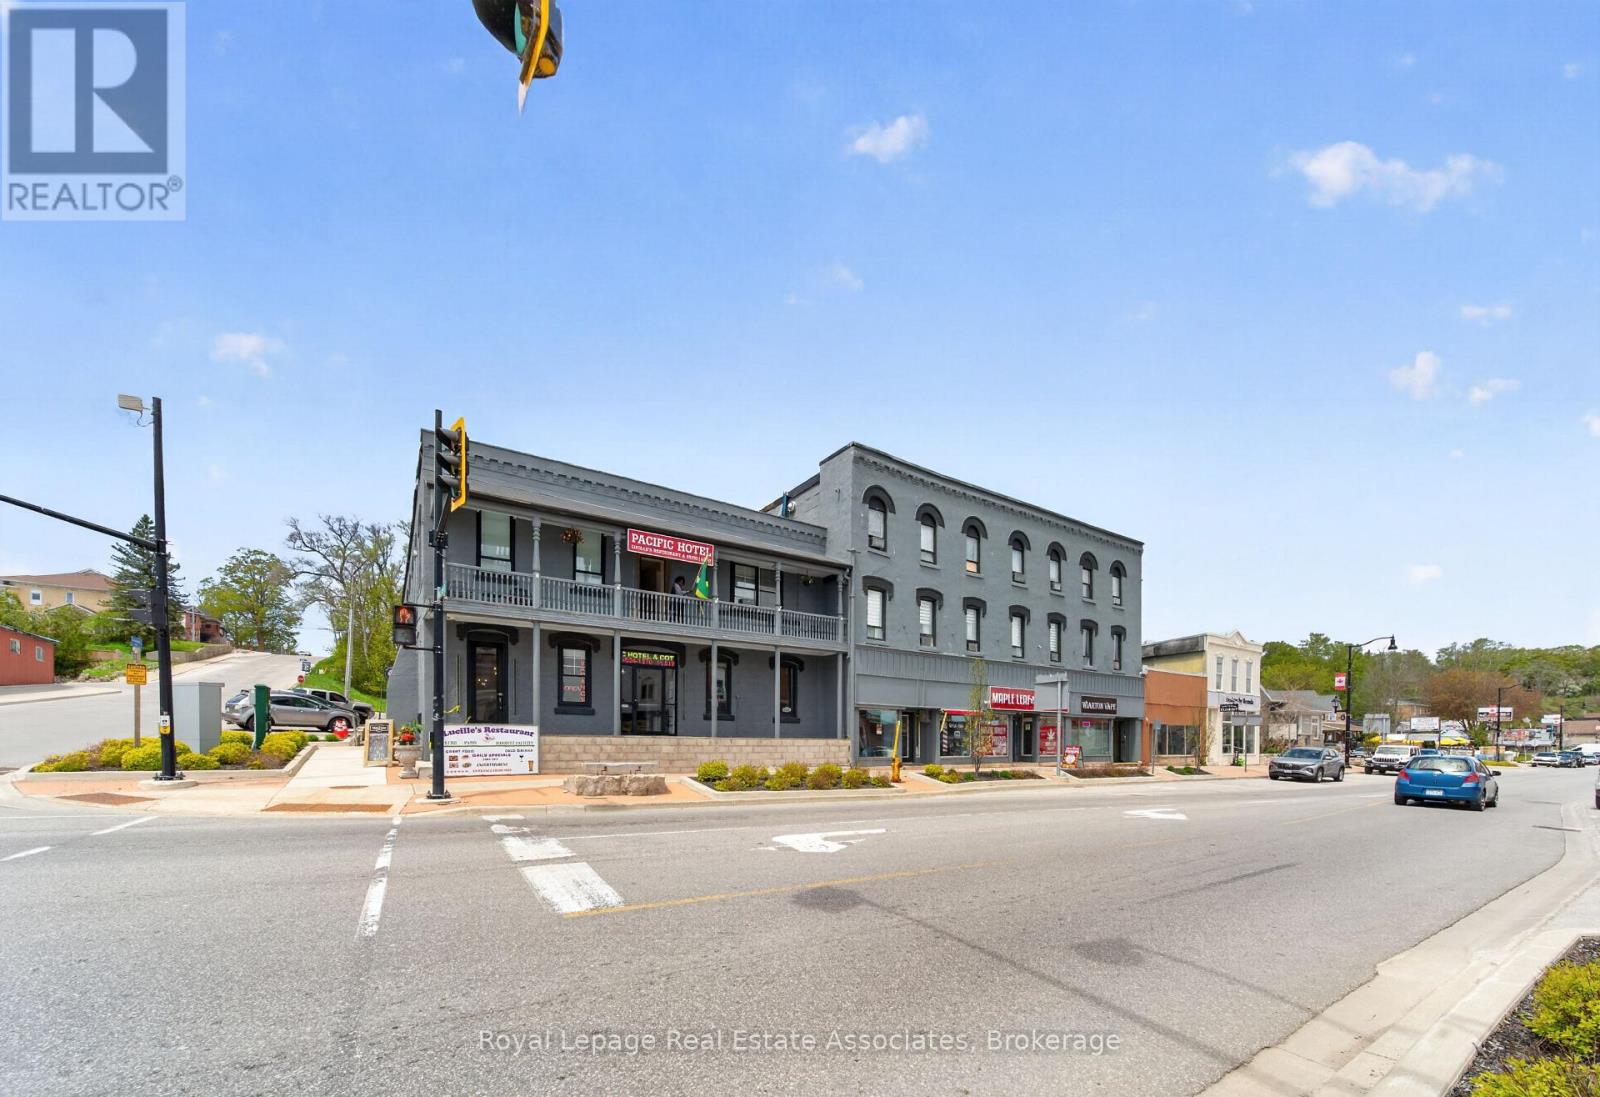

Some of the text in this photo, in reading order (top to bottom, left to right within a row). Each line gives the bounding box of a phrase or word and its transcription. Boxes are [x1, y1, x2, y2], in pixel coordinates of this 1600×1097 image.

[631, 532, 712, 557] PACIFIC HOTEL
[627, 651, 651, 659] HOTEL
[992, 692, 1015, 705] MAPLE
[1104, 702, 1116, 711] VAPE
[443, 726, 535, 737] Lucille's Restaurant
